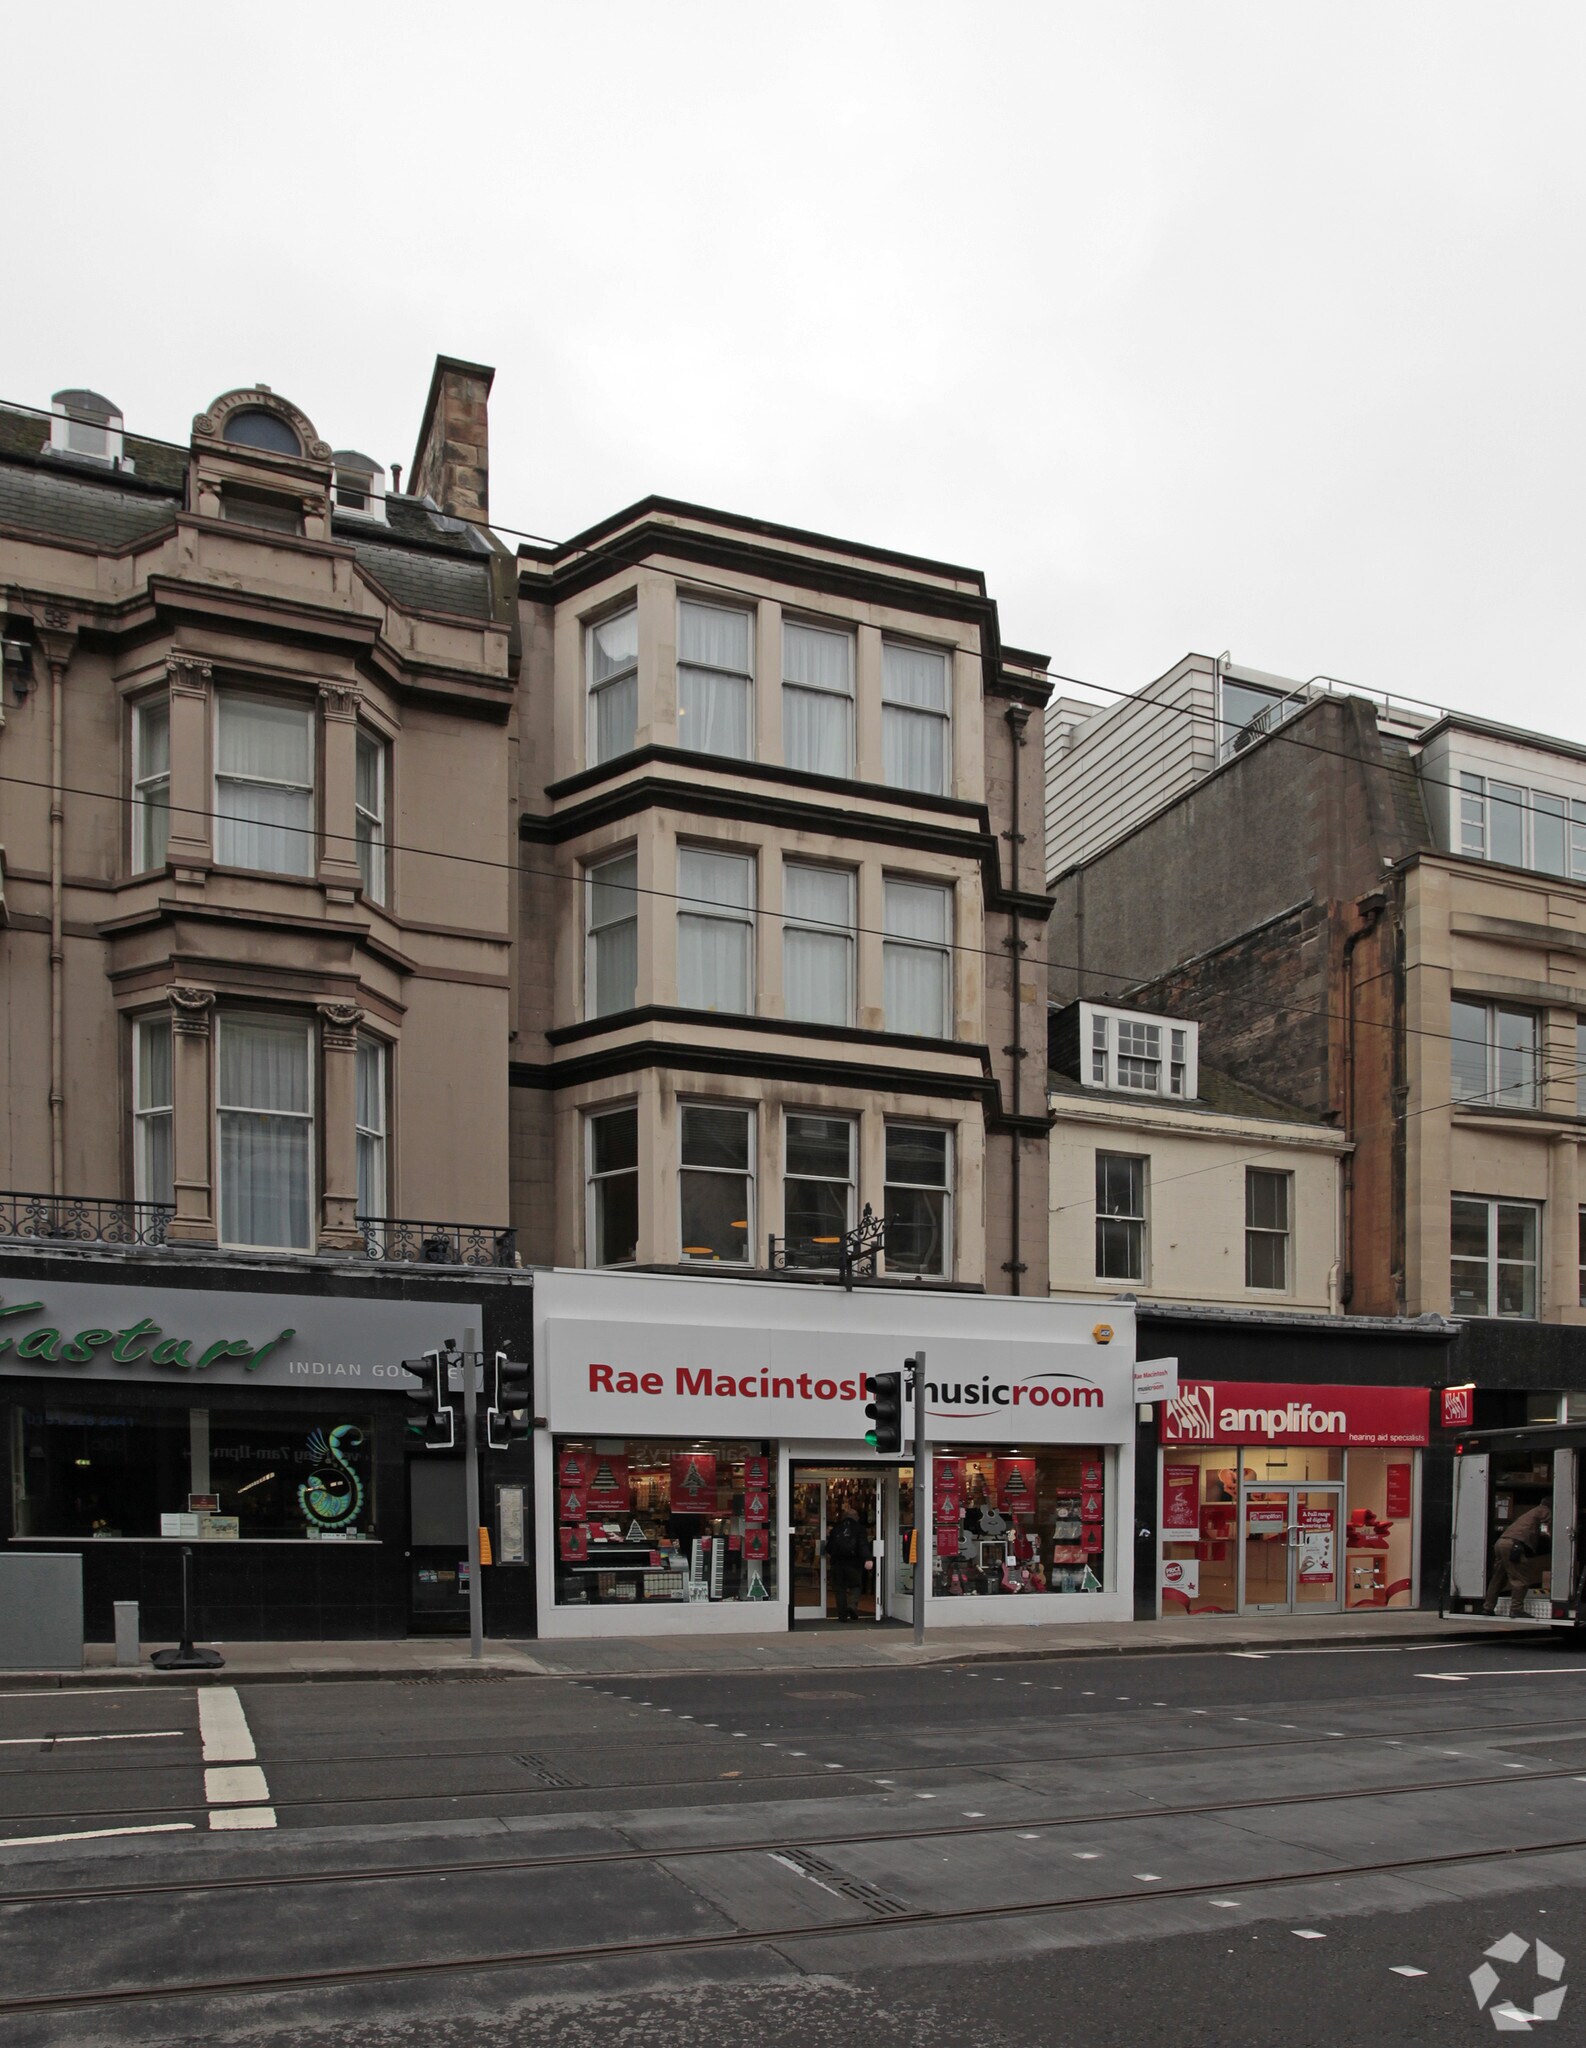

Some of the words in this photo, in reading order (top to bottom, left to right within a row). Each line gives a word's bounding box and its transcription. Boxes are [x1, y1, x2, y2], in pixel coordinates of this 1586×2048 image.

[289, 1361, 361, 1376] INDIAN
[1143, 1369, 1168, 1378] Macintosh
[588, 1364, 664, 1395] Rae
[1219, 1402, 1346, 1439] amplifon
[1349, 1432, 1375, 1443] hearing
[1377, 1432, 1388, 1442] aid
[1390, 1433, 1425, 1444] specialists
